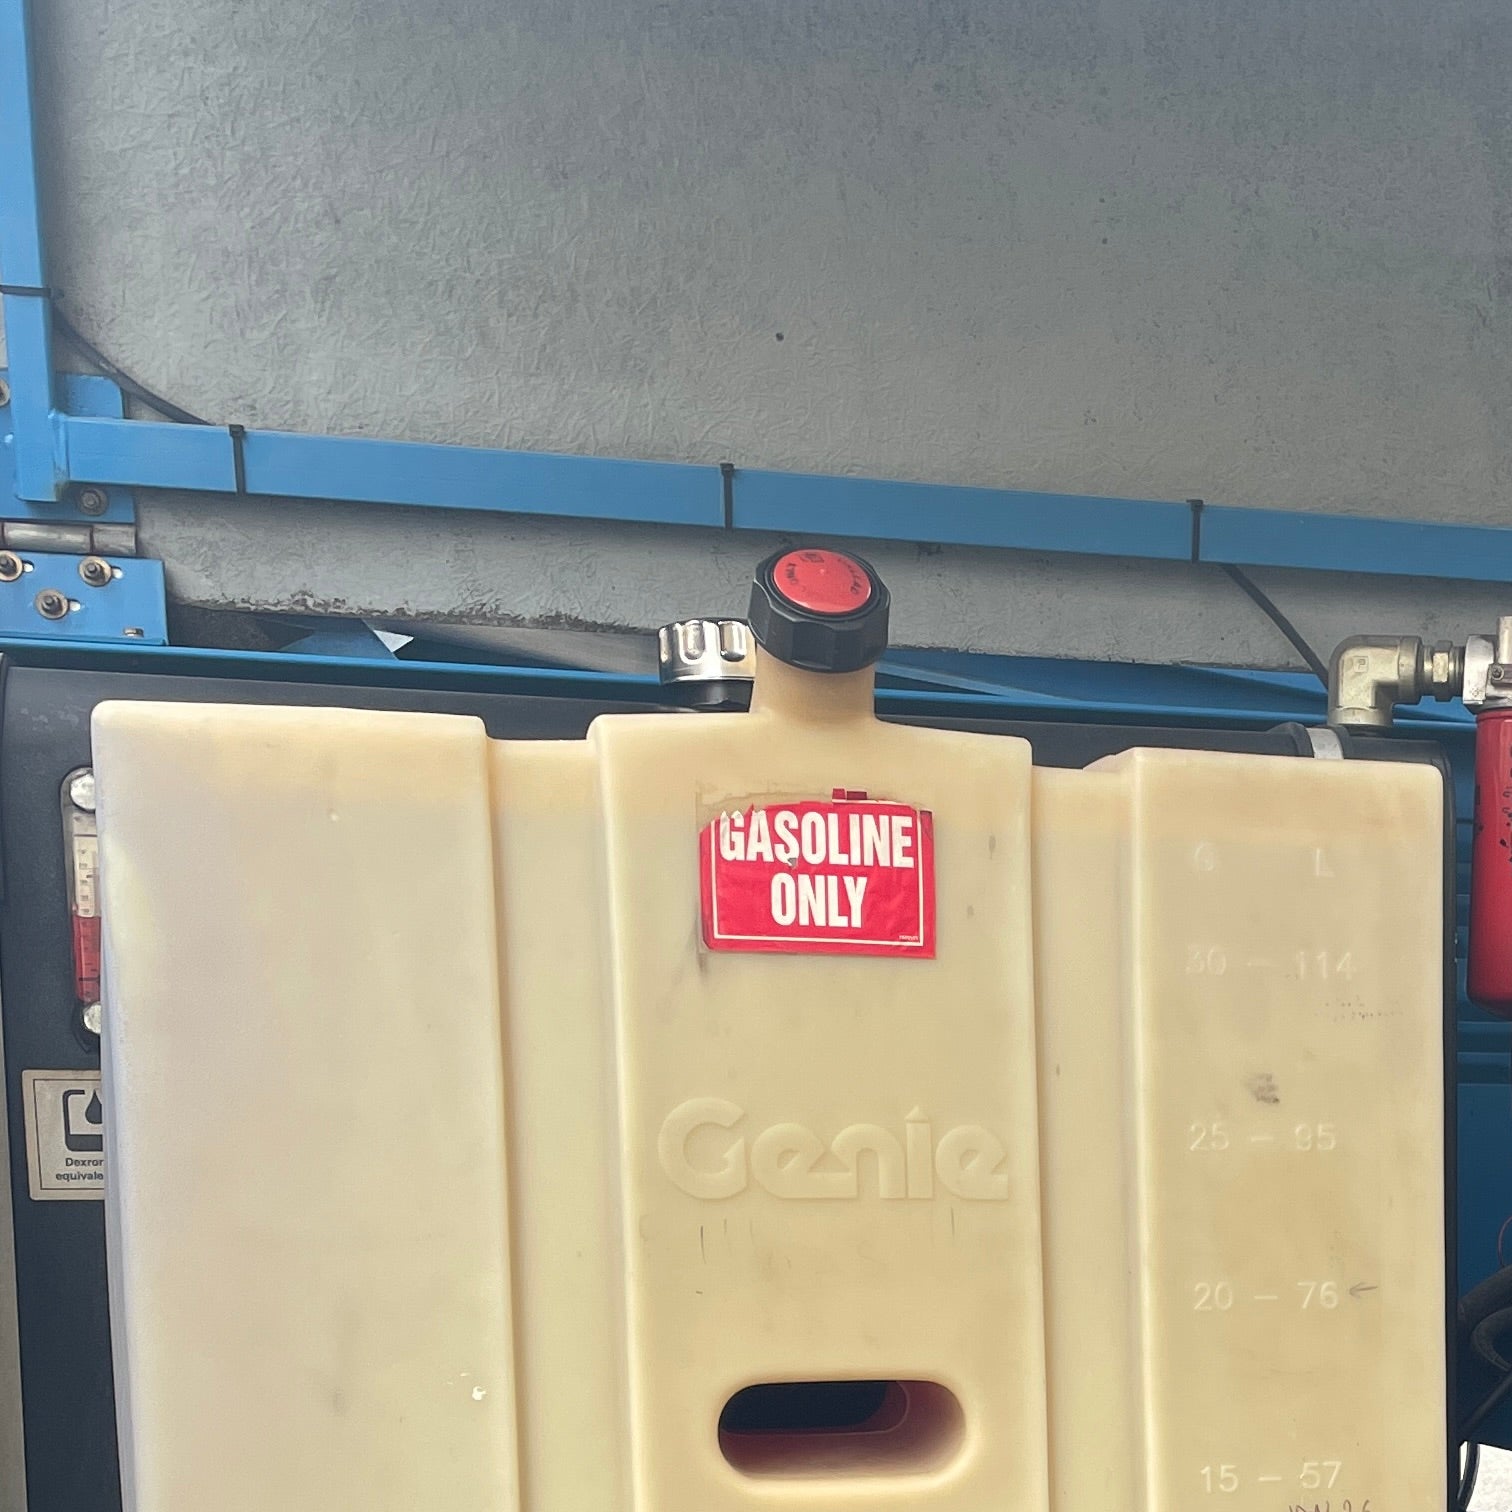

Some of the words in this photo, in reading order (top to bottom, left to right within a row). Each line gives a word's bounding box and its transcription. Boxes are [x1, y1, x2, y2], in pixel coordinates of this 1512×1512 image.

[719, 810, 915, 868] GASOLINE
[770, 872, 869, 930] ONLY
[1296, 950, 1358, 981] 114
[657, 1095, 1011, 1201] Genie
[1188, 1122, 1230, 1152] 25
[1294, 1123, 1337, 1152] 95
[55, 1171, 104, 1183] equivale
[1193, 1281, 1234, 1312] 20
[1296, 1279, 1340, 1310] 76
[1199, 1463, 1240, 1494] 15
[1299, 1460, 1342, 1490] 57
